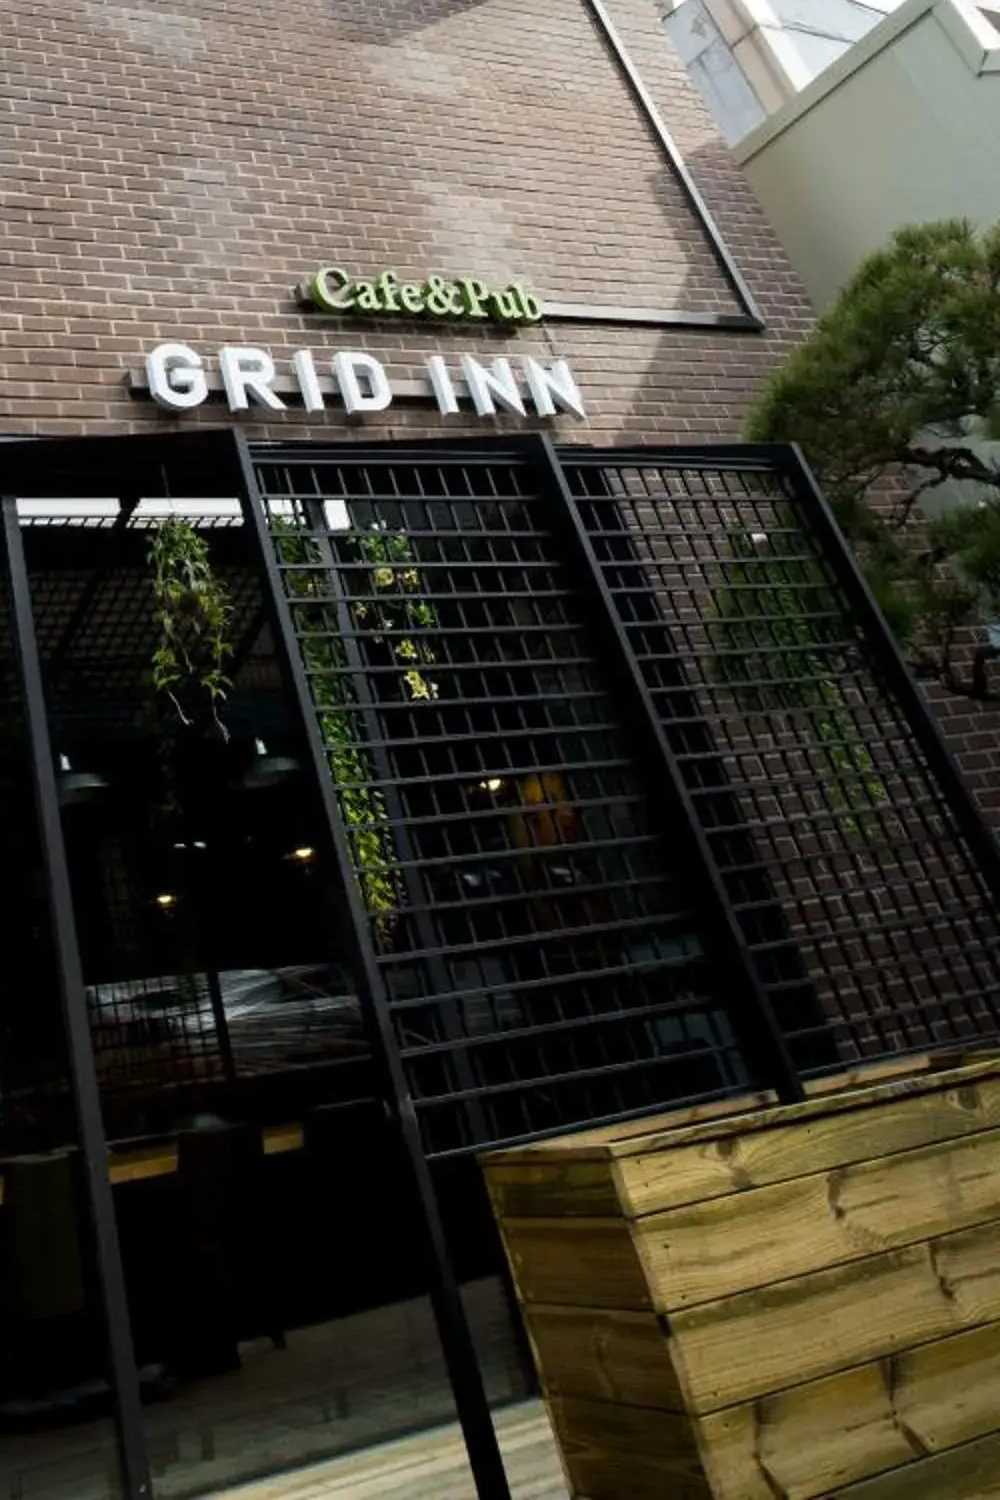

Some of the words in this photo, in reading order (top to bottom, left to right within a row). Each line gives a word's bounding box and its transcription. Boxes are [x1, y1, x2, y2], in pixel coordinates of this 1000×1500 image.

[309, 266, 544, 322] Cafe&Pub
[145, 342, 393, 414] GRID
[428, 353, 588, 423] INN
